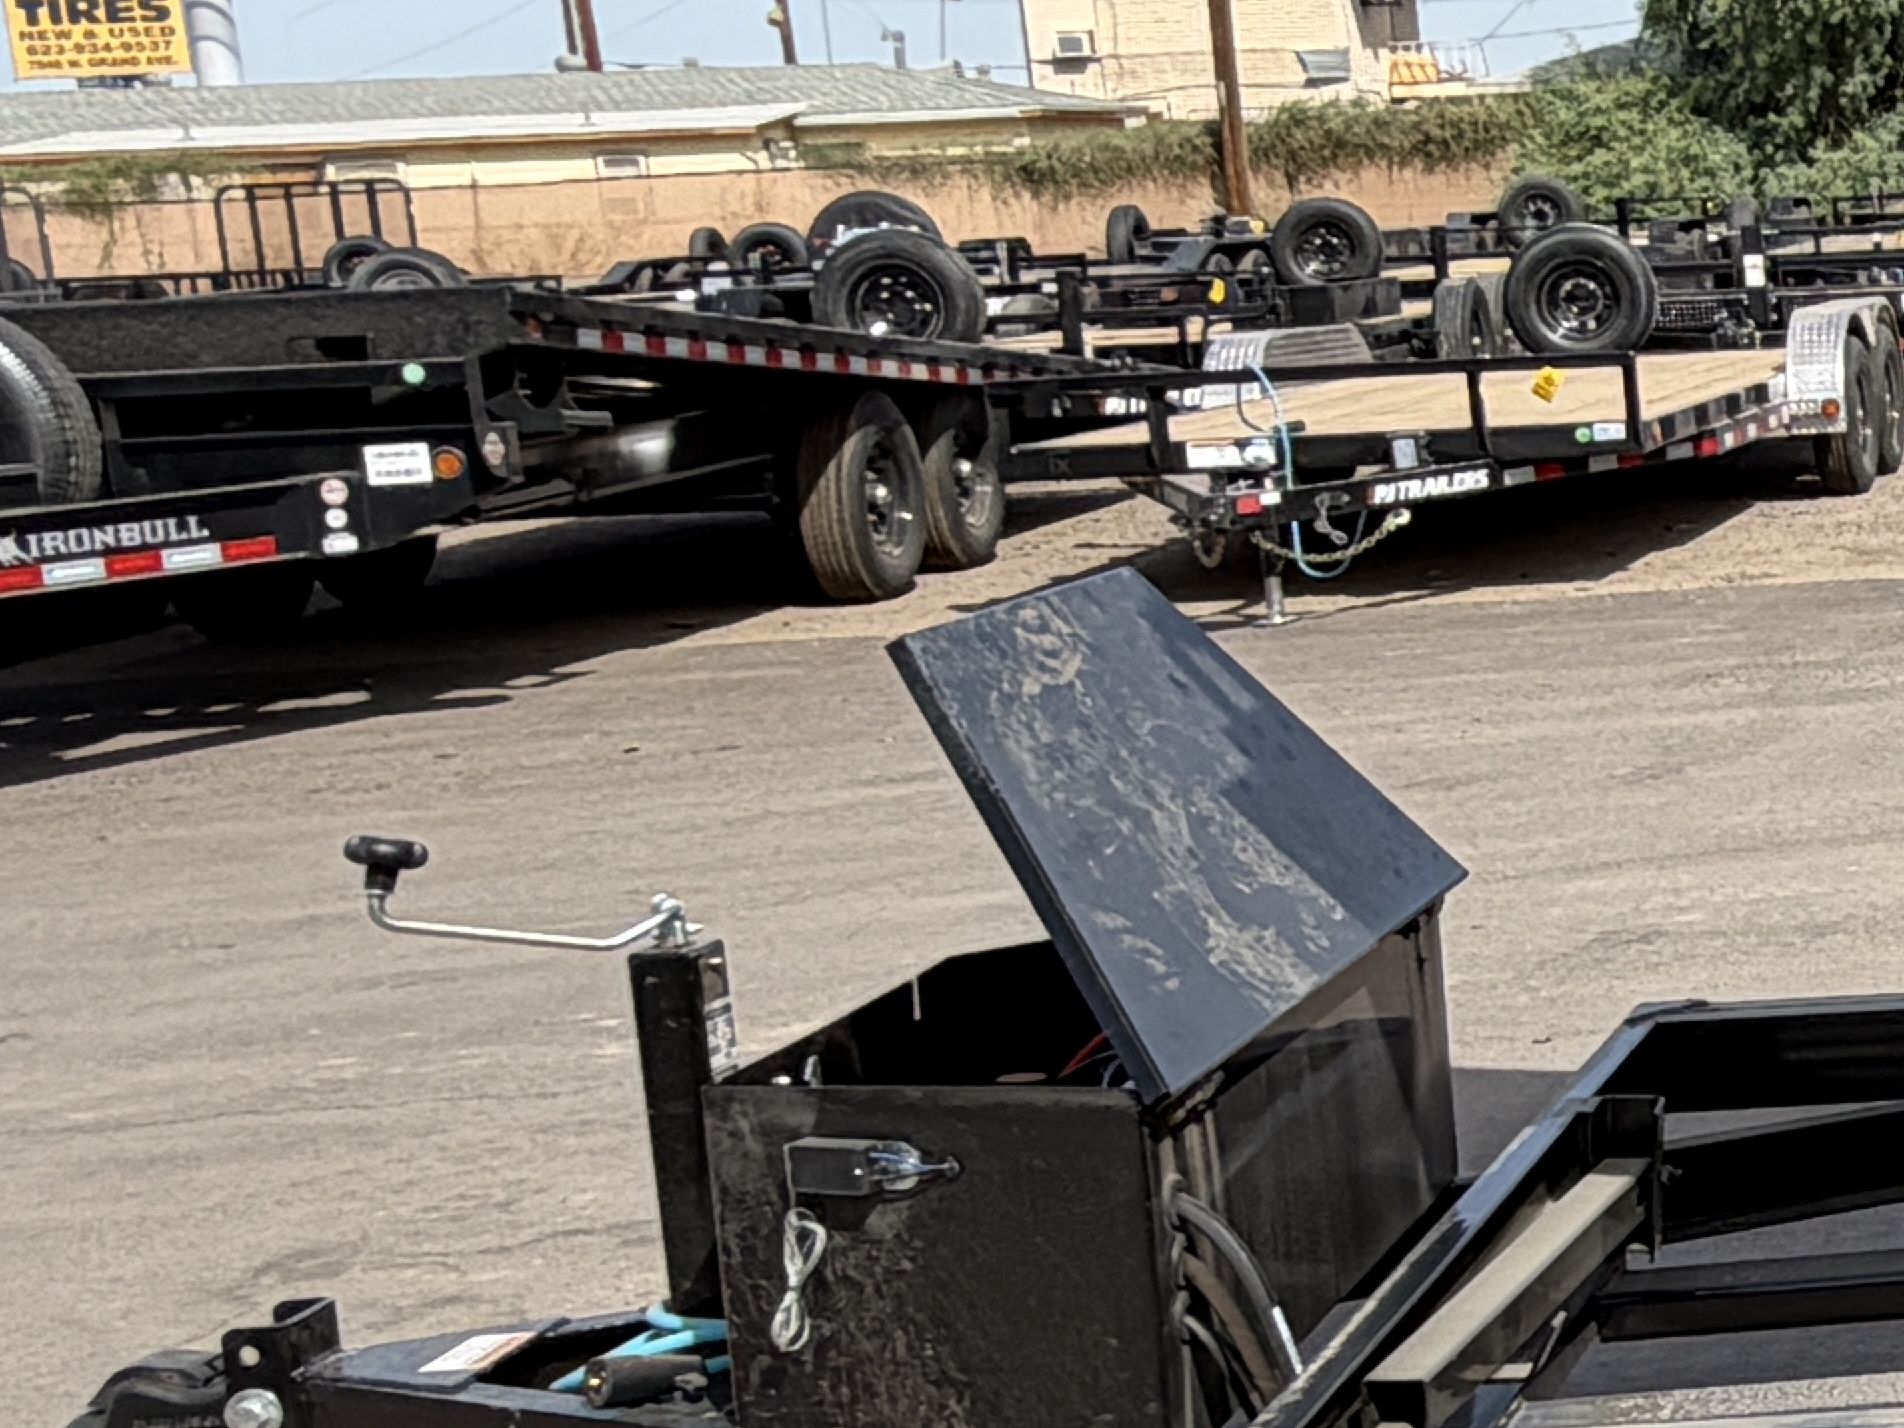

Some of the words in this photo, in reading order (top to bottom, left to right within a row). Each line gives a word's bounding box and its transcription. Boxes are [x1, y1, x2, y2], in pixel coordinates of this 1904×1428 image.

[19, 28, 73, 42] NEW
[108, 26, 176, 39] USED
[25, 515, 210, 558] IRONBULL
